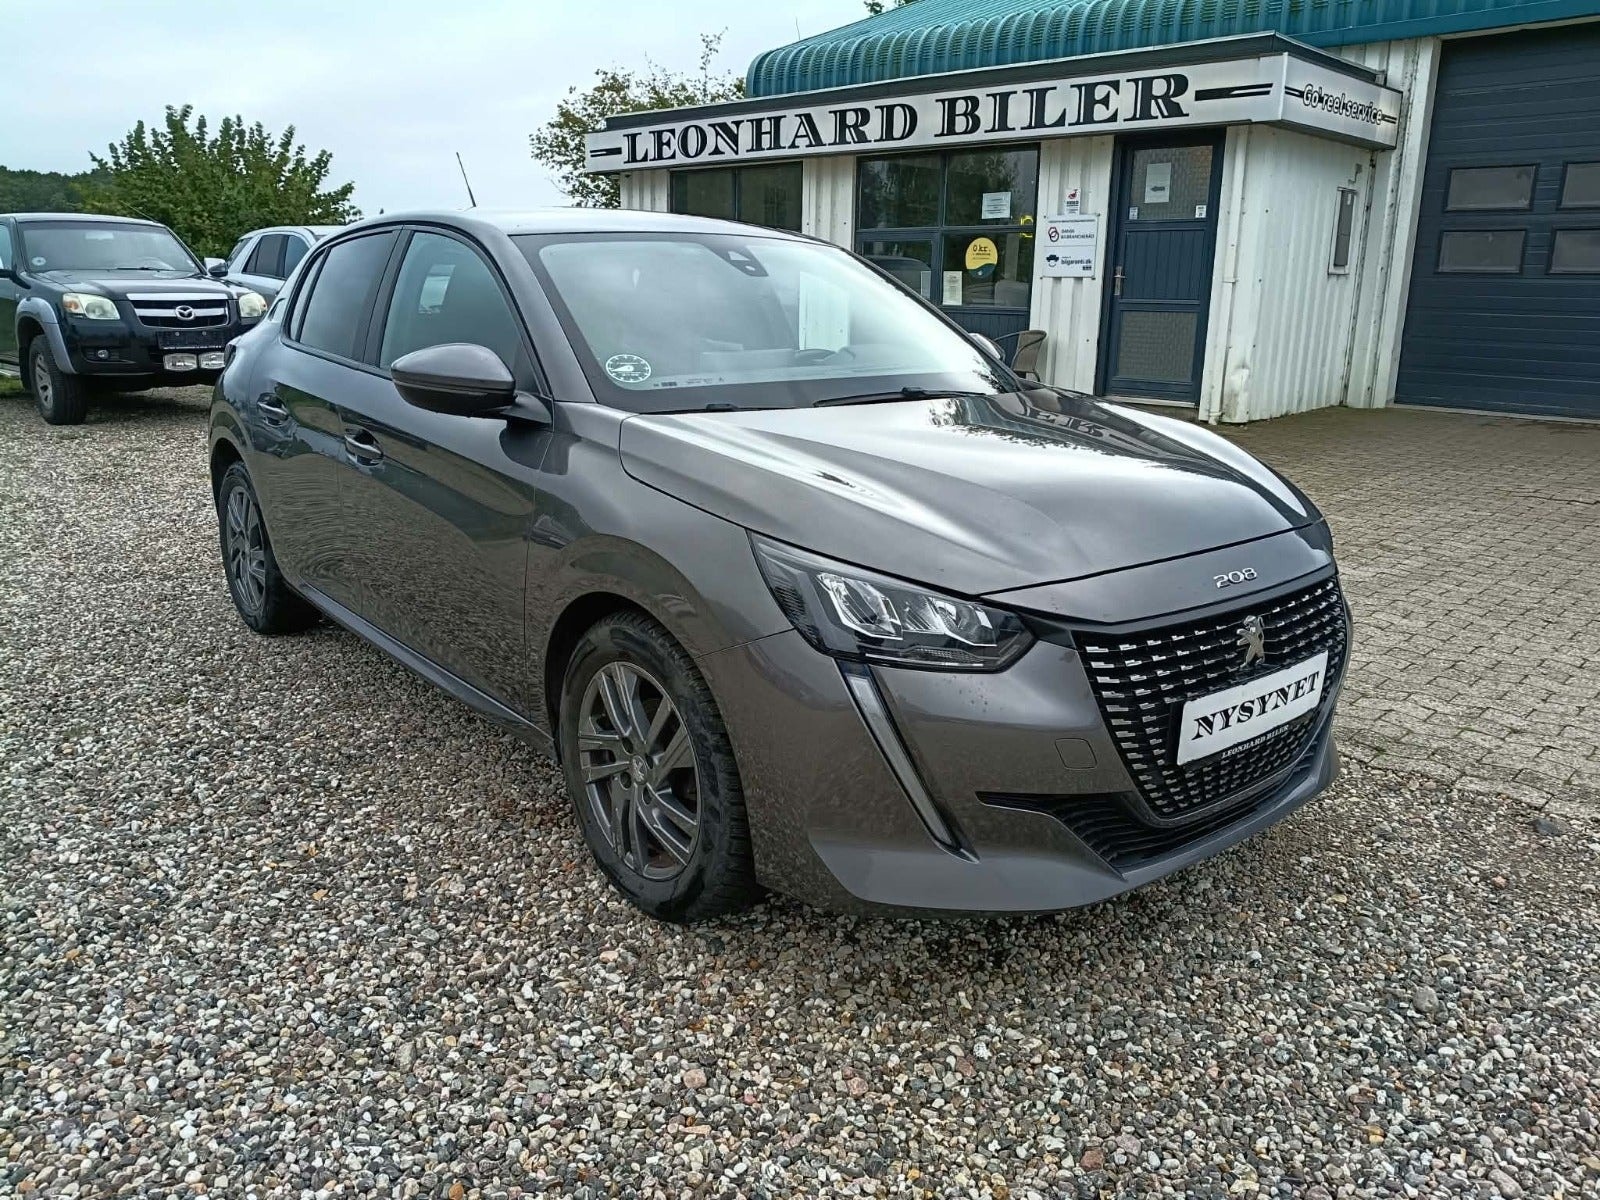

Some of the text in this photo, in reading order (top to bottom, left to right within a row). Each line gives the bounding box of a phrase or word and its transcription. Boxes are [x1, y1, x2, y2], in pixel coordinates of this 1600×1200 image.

[623, 73, 1190, 165] LEONHARD BILER
[1322, 92, 1346, 116] reel
[1345, 100, 1383, 126] service
[1213, 567, 1258, 589] 208
[1191, 671, 1320, 741] NYSYNET
[1221, 724, 1290, 759] LEONHARD BILER
